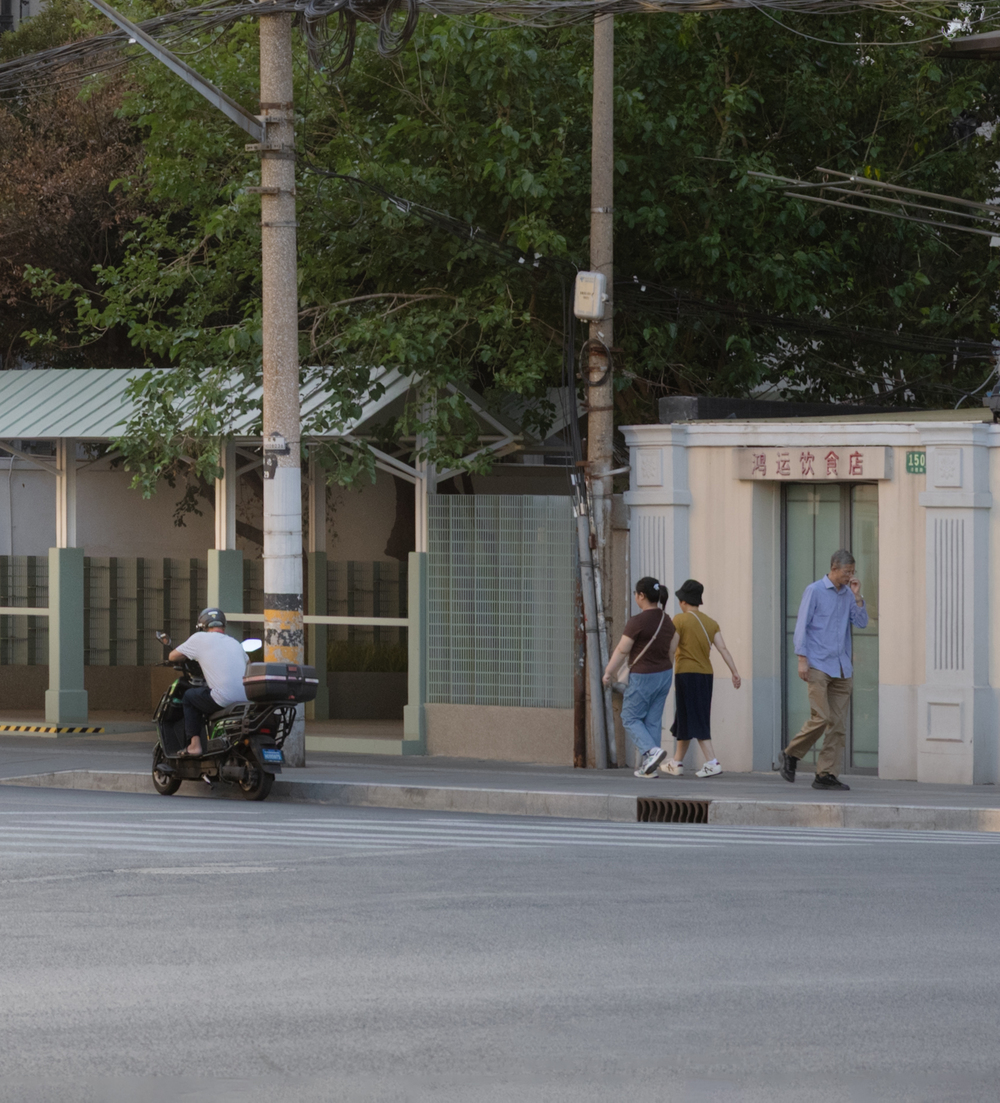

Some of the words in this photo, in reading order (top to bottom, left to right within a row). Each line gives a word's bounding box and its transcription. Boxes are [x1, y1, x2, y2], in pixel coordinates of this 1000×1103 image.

[752, 450, 863, 476] 鸿运饮食店
[908, 454, 925, 466] 150
